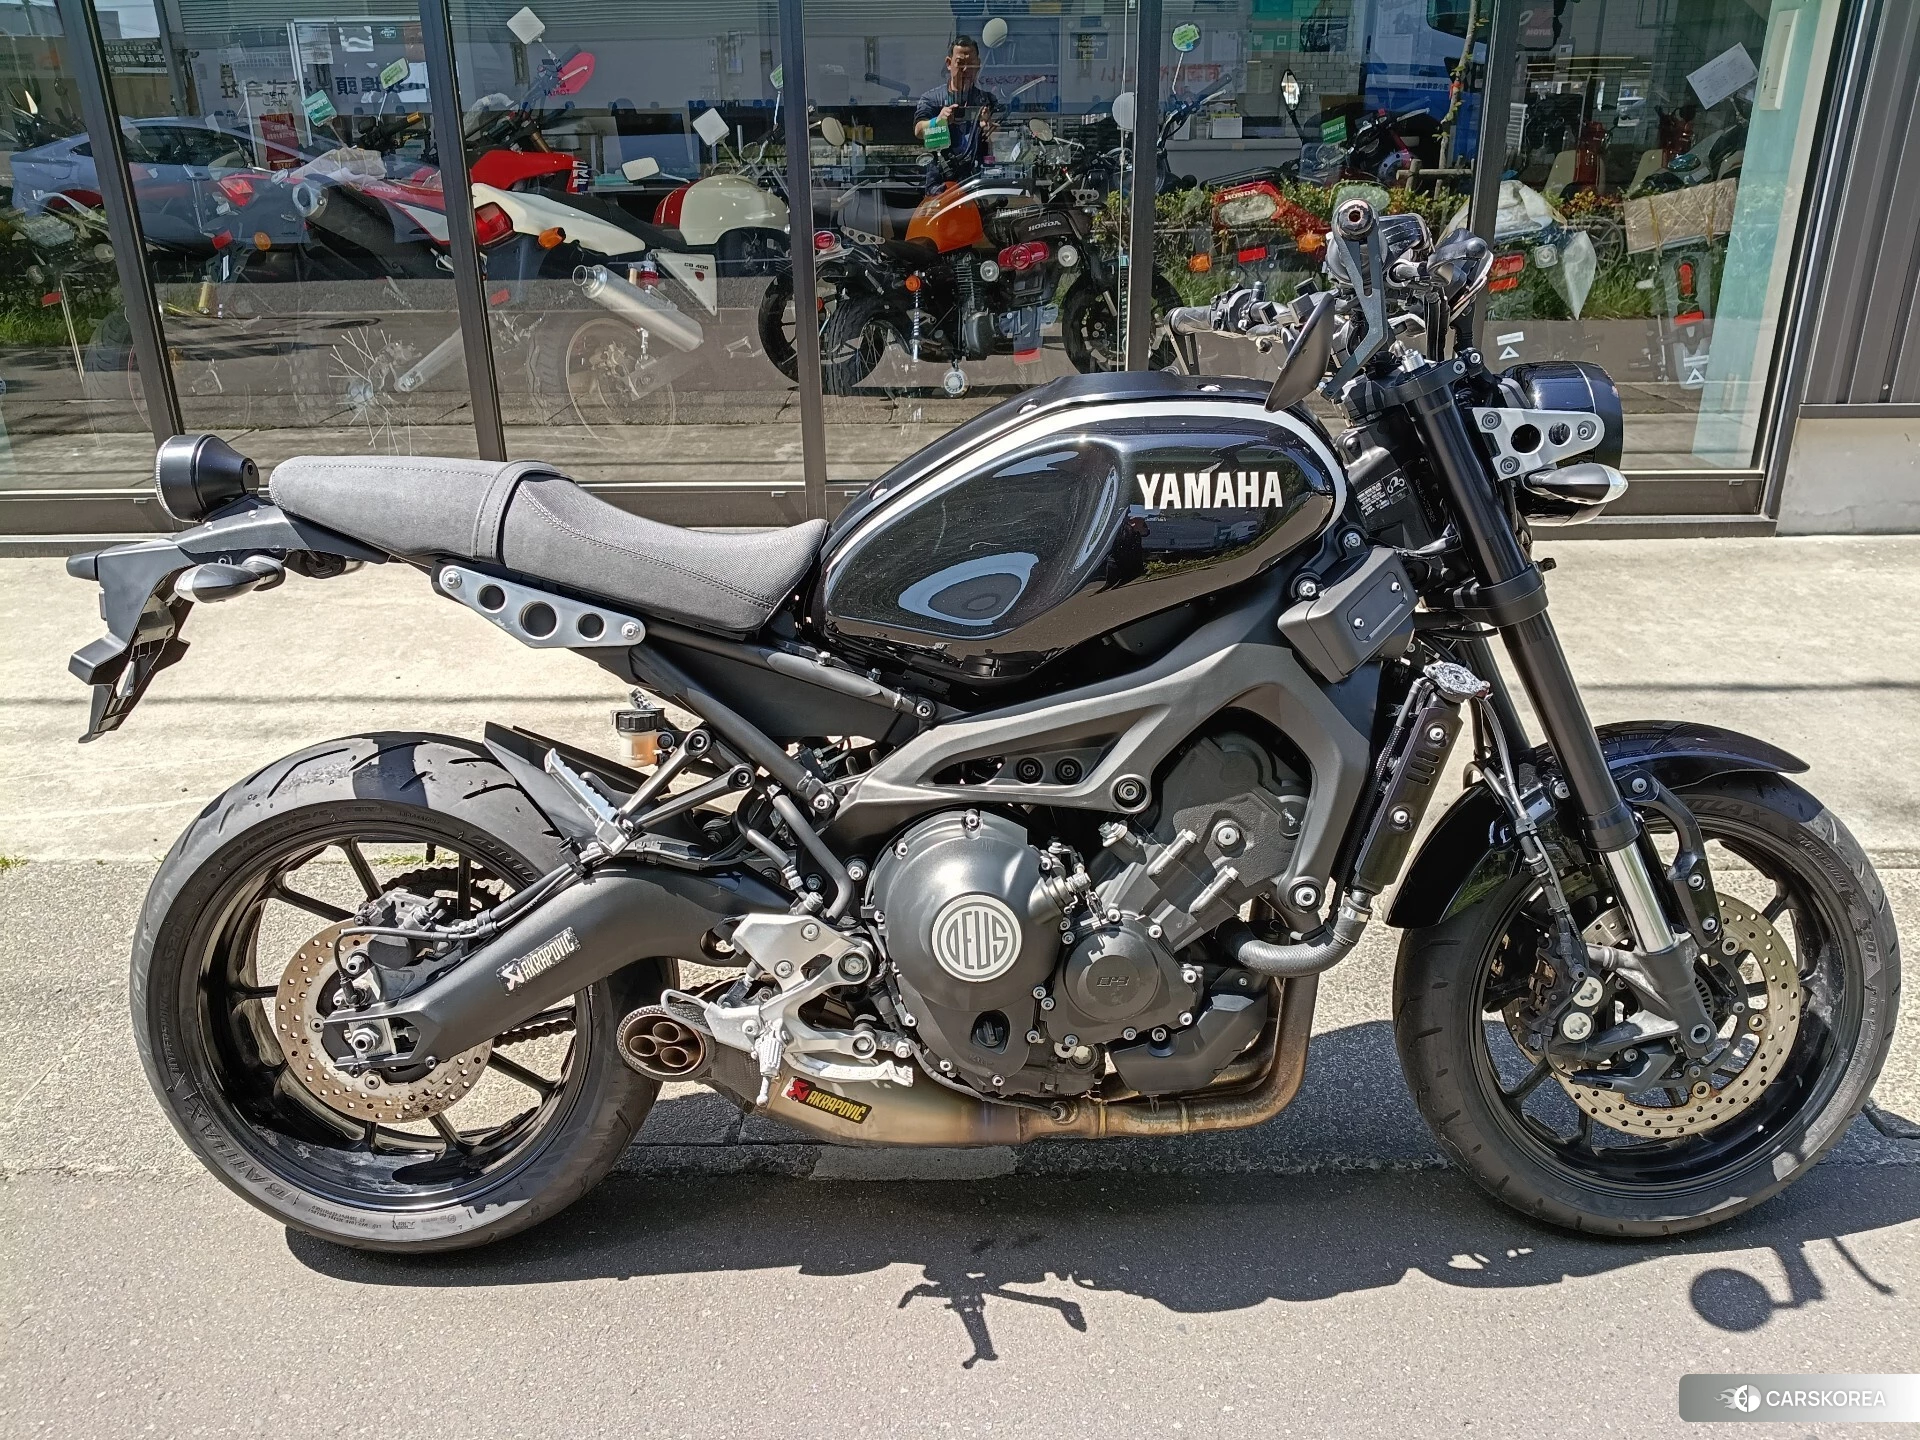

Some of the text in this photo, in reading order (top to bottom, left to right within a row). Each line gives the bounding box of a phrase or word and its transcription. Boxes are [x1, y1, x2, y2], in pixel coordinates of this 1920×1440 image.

[1224, 189, 1258, 200] HONDA
[1028, 220, 1061, 231] HONDA
[1136, 471, 1283, 510] YAMAHA
[946, 910, 1009, 970] DEUS
[805, 1091, 867, 1121] AKRAPOVIČ
